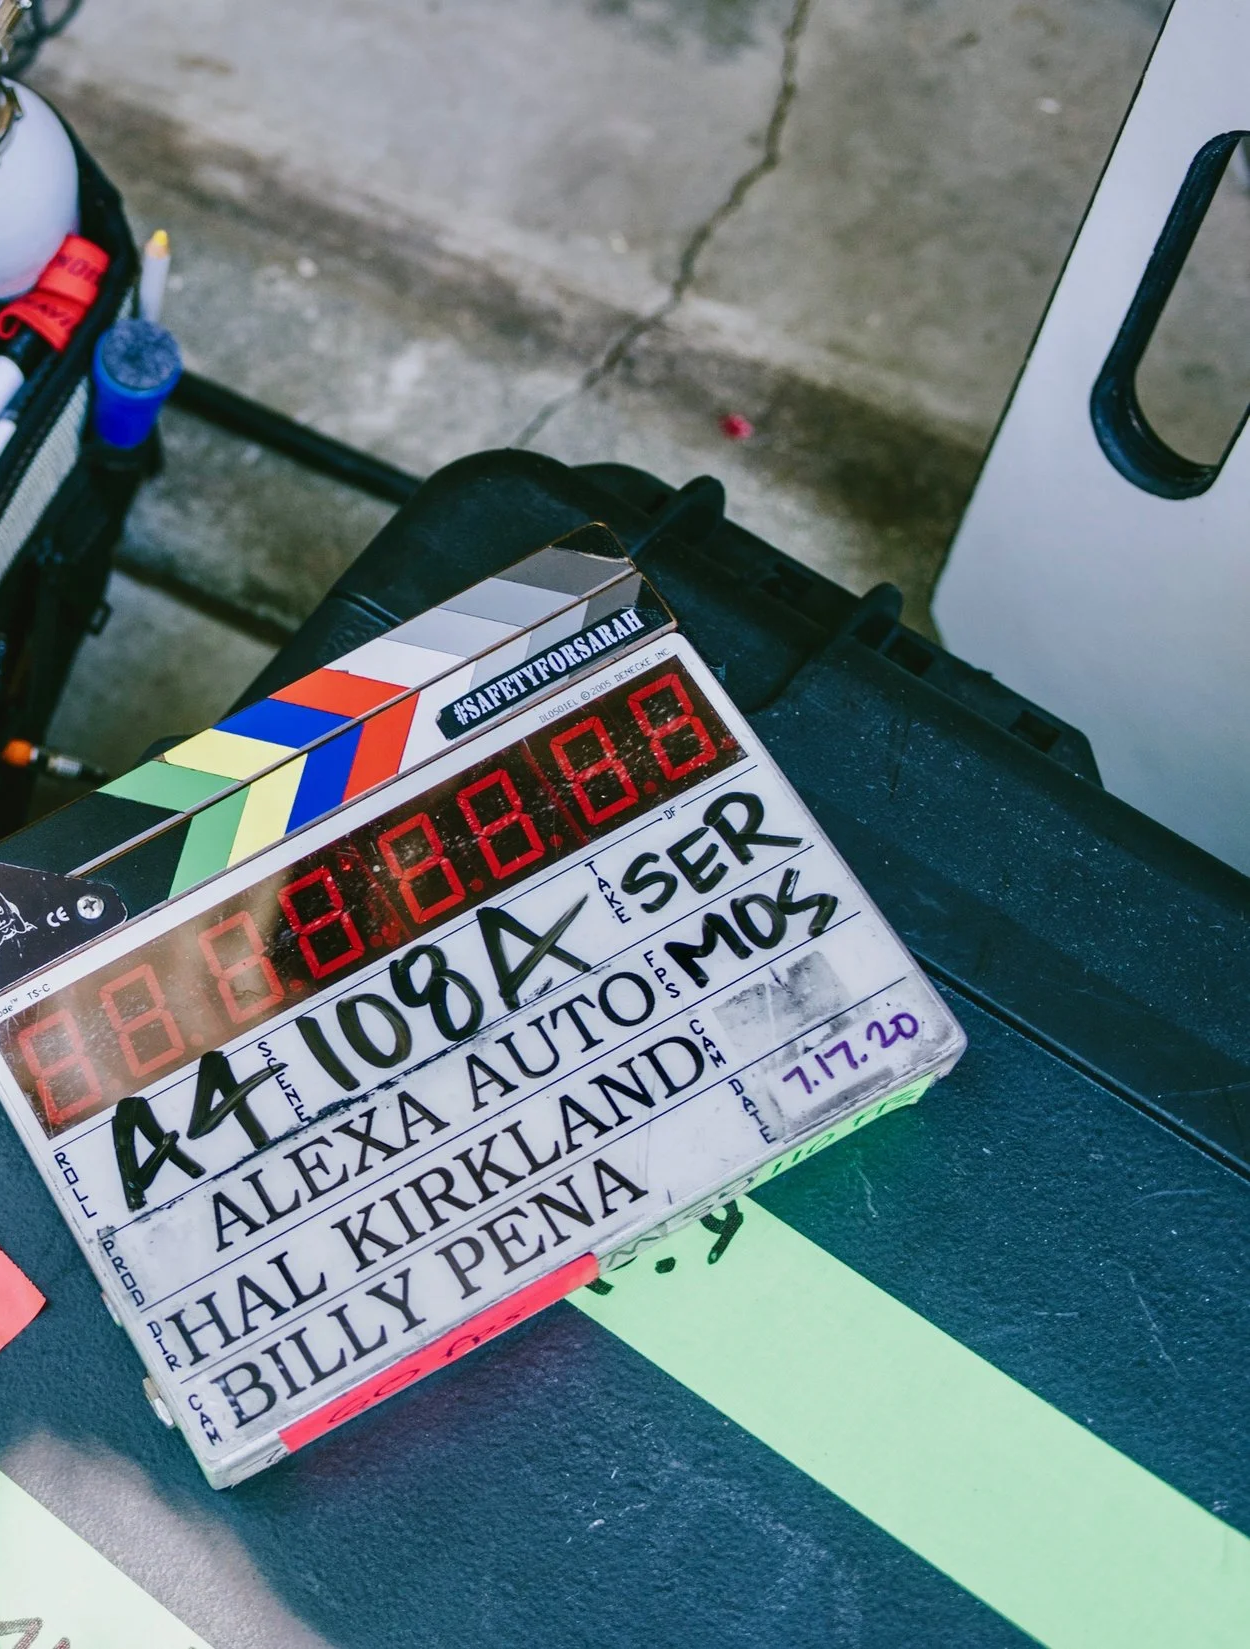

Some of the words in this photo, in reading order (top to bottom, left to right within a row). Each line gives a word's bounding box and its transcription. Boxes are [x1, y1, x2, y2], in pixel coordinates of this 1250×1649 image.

[454, 608, 645, 727] #SAFETYFORSARAH
[615, 656, 652, 682] DENECKE
[663, 806, 677, 820] DF
[621, 792, 806, 913] SER
[585, 861, 631, 923] TAKE
[664, 868, 839, 989] MOS
[295, 893, 592, 1092] 108A
[644, 950, 680, 999] FPS
[689, 1019, 726, 1068] CAM
[212, 1090, 451, 1253] ALEXA
[465, 971, 656, 1112] AUTO
[257, 1041, 312, 1124] SCENE
[728, 1078, 776, 1144] DATE
[112, 1050, 288, 1212] A4
[54, 1152, 97, 1219] ROLL
[165, 1251, 327, 1367] HAL
[331, 1036, 705, 1273] KIRKLAND
[102, 1240, 145, 1308] PROD
[210, 1267, 427, 1430] BILLY
[434, 1157, 650, 1300] PENA
[147, 1321, 181, 1373] DIR
[188, 1393, 222, 1446] CAM
